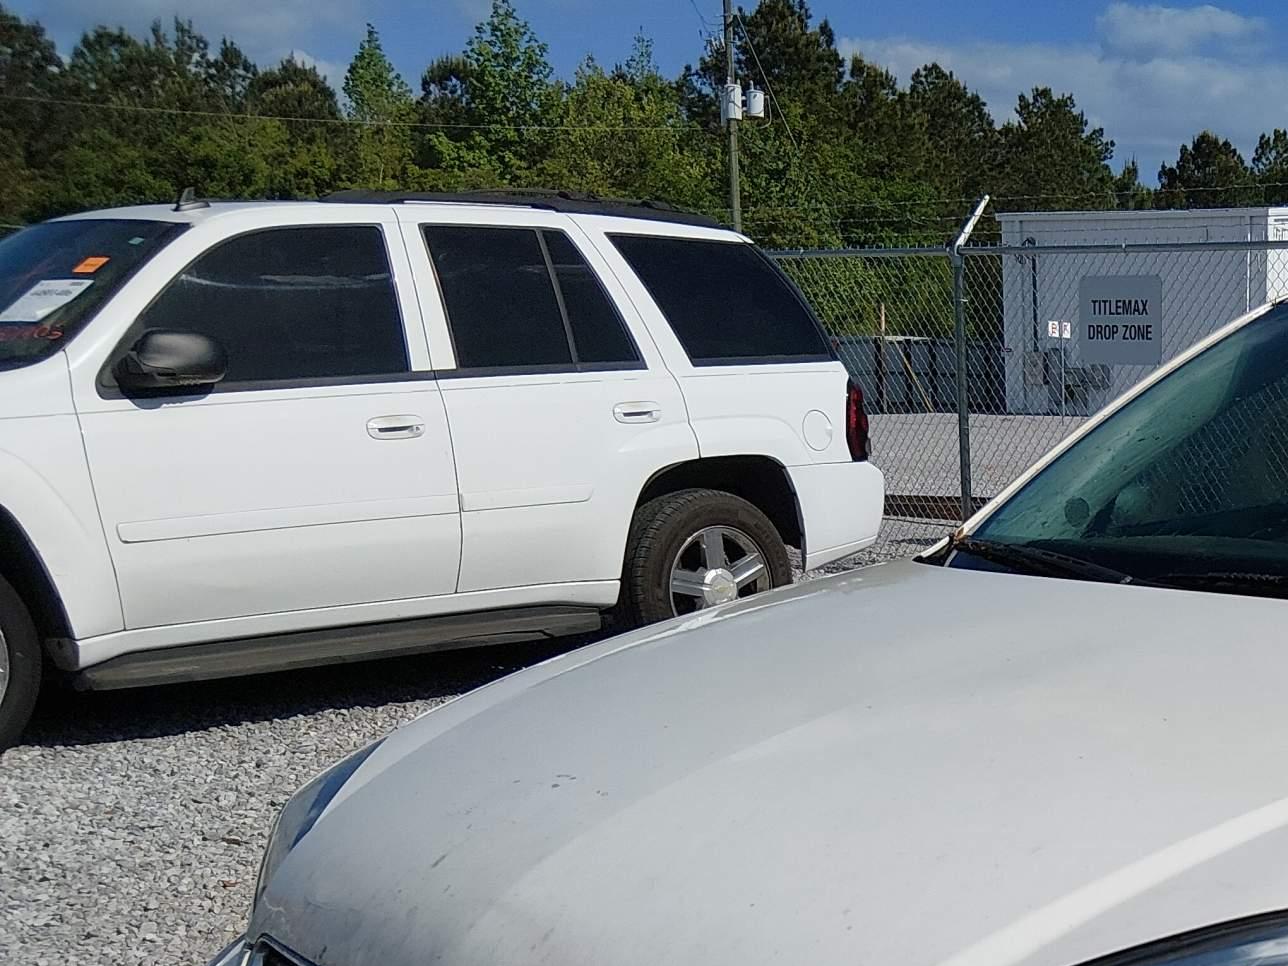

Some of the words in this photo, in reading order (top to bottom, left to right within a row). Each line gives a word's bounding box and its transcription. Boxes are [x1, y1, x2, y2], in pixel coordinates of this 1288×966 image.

[1091, 299, 1148, 316] TITLEMAX
[1087, 324, 1119, 341] DROP
[1122, 324, 1153, 341] ZONE
